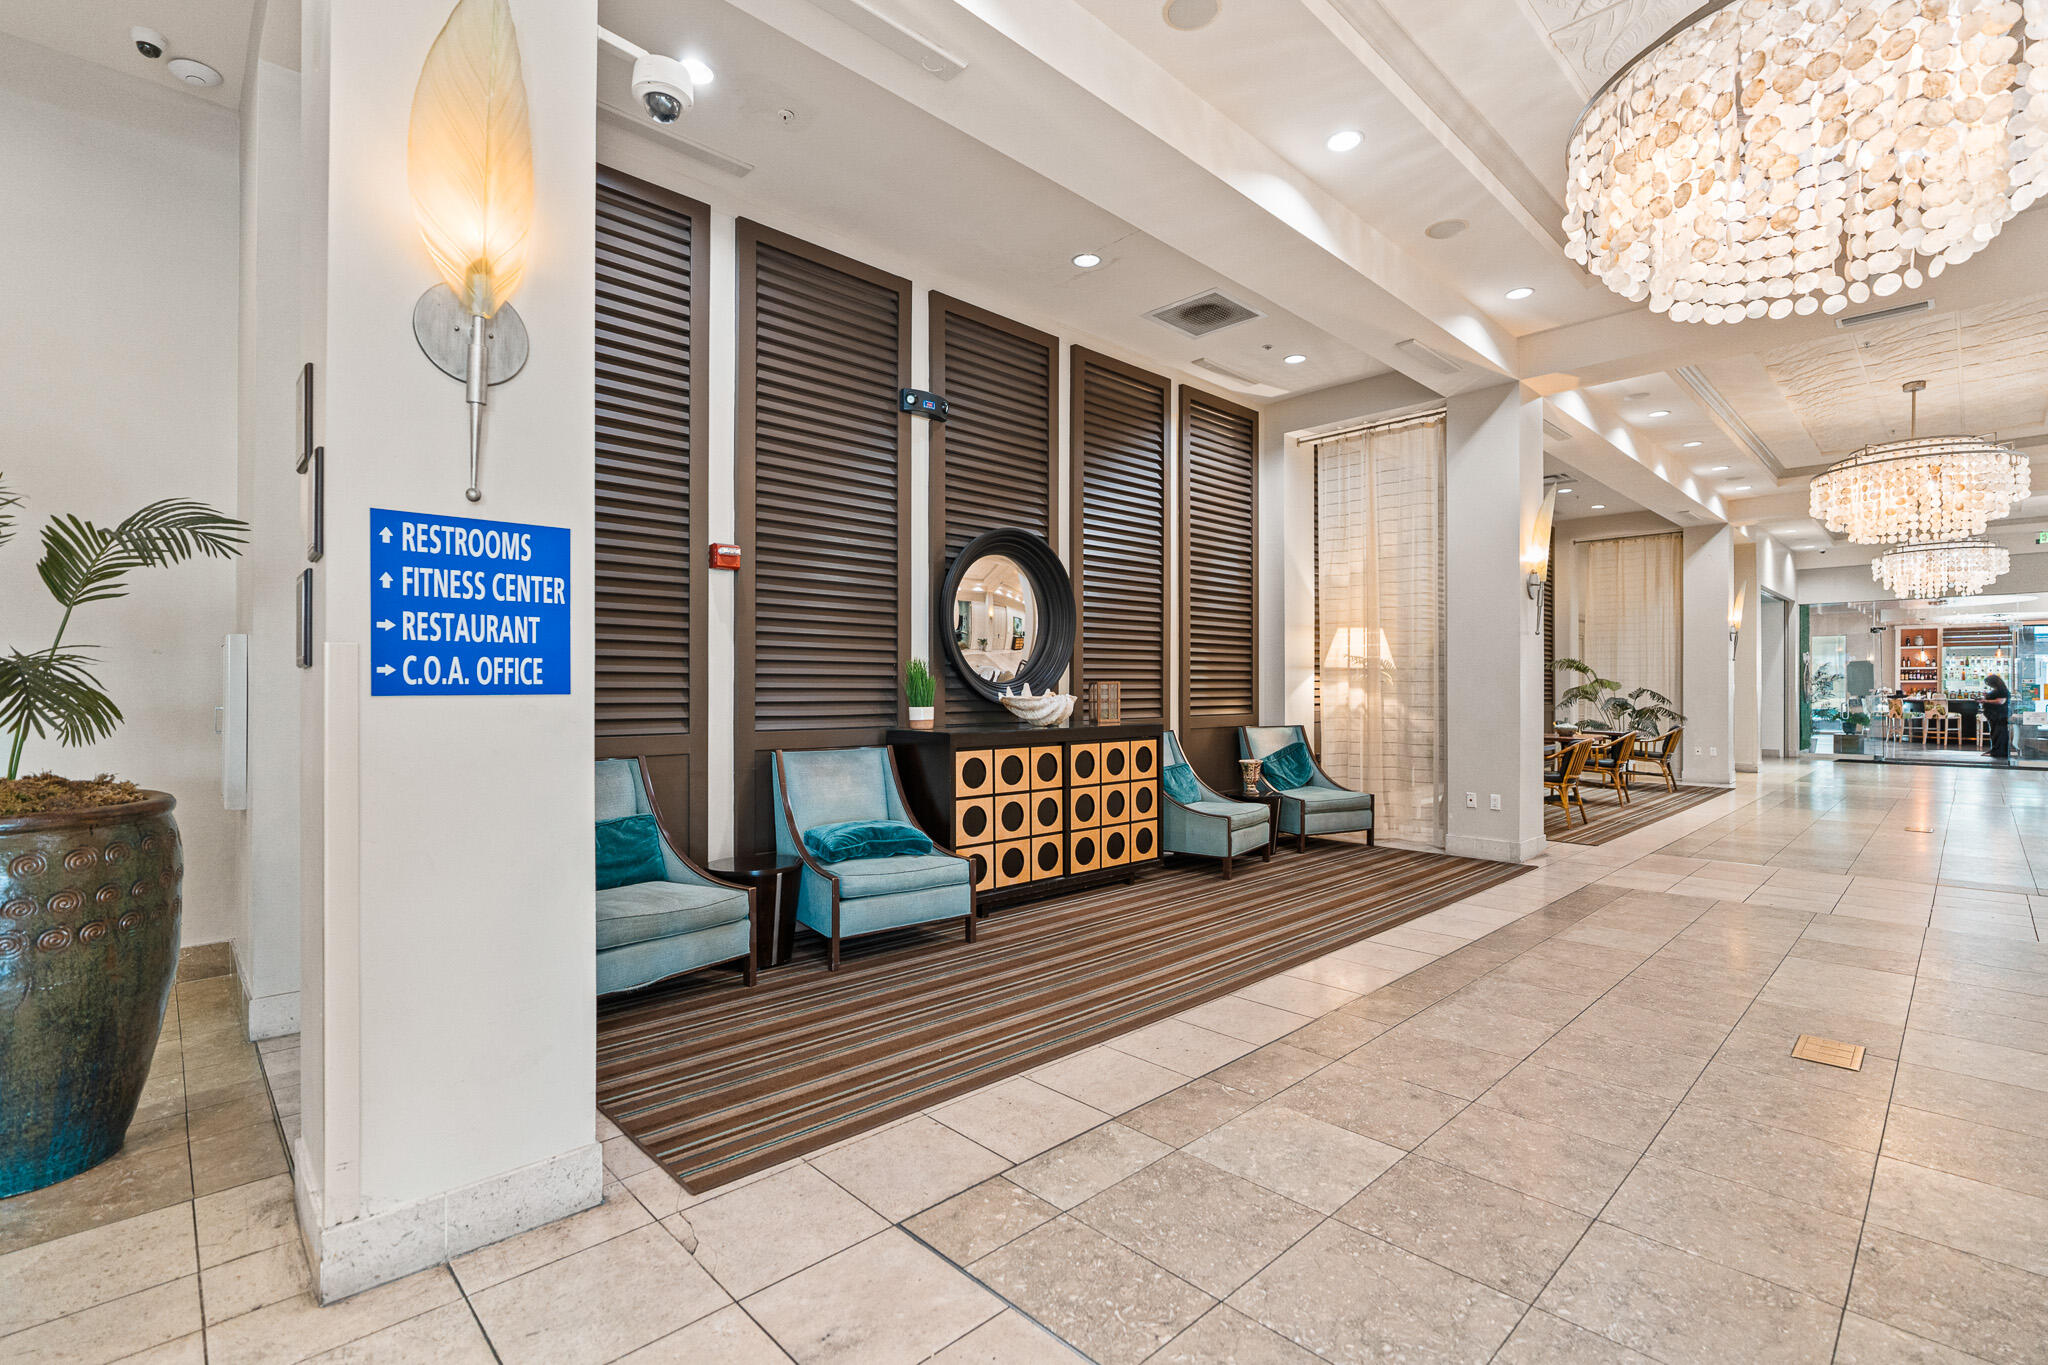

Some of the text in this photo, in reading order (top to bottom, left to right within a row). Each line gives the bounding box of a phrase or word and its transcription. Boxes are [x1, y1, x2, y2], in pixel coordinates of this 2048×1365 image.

[402, 521, 532, 562] RESTROOMS
[402, 566, 566, 605] FITNESS CENTER
[402, 611, 541, 644] RESTAURANT
[402, 655, 543, 686] C.O.A. OFFICE
